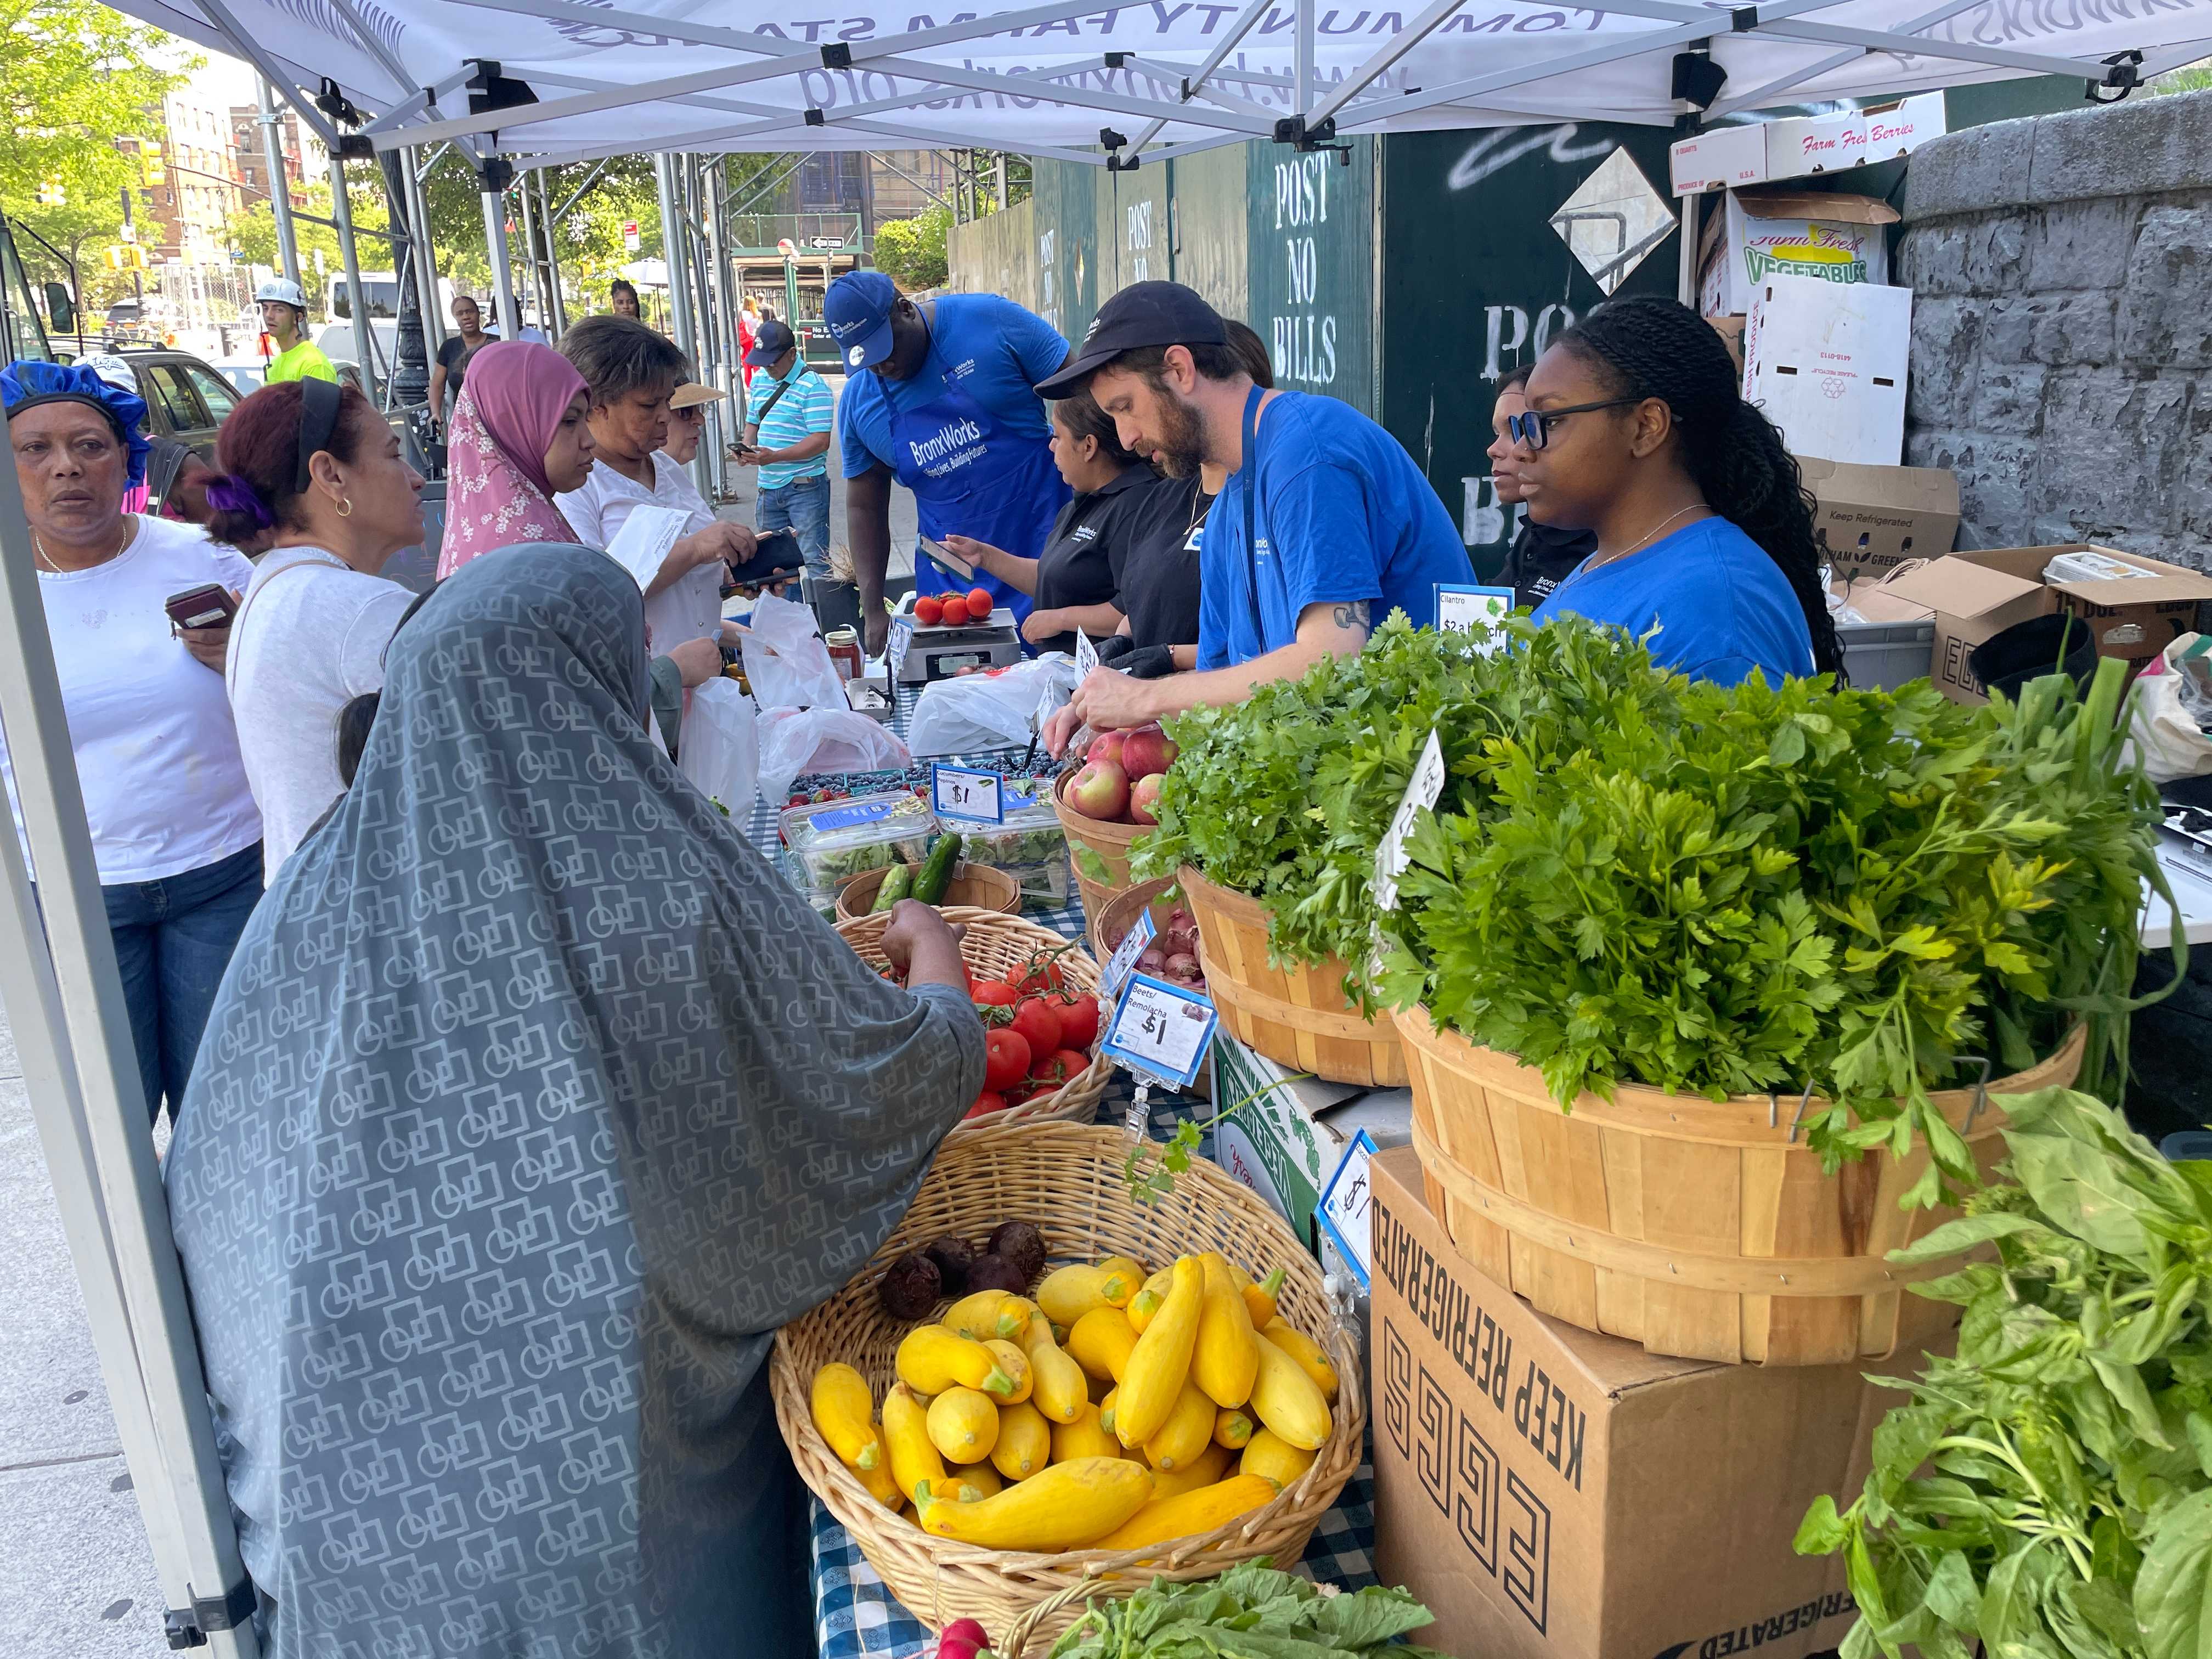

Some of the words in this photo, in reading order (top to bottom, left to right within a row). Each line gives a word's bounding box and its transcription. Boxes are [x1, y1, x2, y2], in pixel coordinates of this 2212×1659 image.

[1802, 136, 1836, 155] Farm
[1841, 129, 1867, 150] Fres
[1871, 123, 1915, 142] Berries
[1274, 150, 1331, 230] POST
[1678, 180, 1699, 191] PRODUCE
[1739, 171, 1756, 179] U.S.A.
[1127, 200, 1153, 251] POST
[1813, 228, 1866, 255] Fresh
[1040, 228, 1054, 268] POST
[1286, 236, 1317, 304] NO
[1044, 271, 1052, 305] NO
[1748, 300, 1759, 366] PRODUCE
[1272, 315, 1337, 384] BILLS
[909, 417, 980, 466] BronxWorks
[949, 452, 972, 465] Building
[967, 444, 988, 460] Futures
[1830, 511, 1853, 522] Keep
[1855, 514, 1913, 527] Refrigerated
[1871, 555, 1909, 567] GREEN
[1536, 576, 1560, 588] Bronx
[1441, 595, 1465, 605] Cilantro
[1444, 619, 1457, 632] $2
[1459, 623, 1464, 632] a
[936, 769, 965, 779] Cucumbers/
[952, 785, 969, 804] $1
[1132, 984, 1158, 999] Beets/
[1127, 997, 1167, 1019] Remolacha
[1141, 1013, 1166, 1045] $1
[1224, 1063, 1295, 1223] VEGETABLES
[1373, 1195, 1513, 1414] REFRIGERATED
[1514, 1359, 1587, 1493] KEEP
[1384, 1314, 1551, 1639] EGGS
[1699, 1592, 1860, 1659] FRIGERATED
